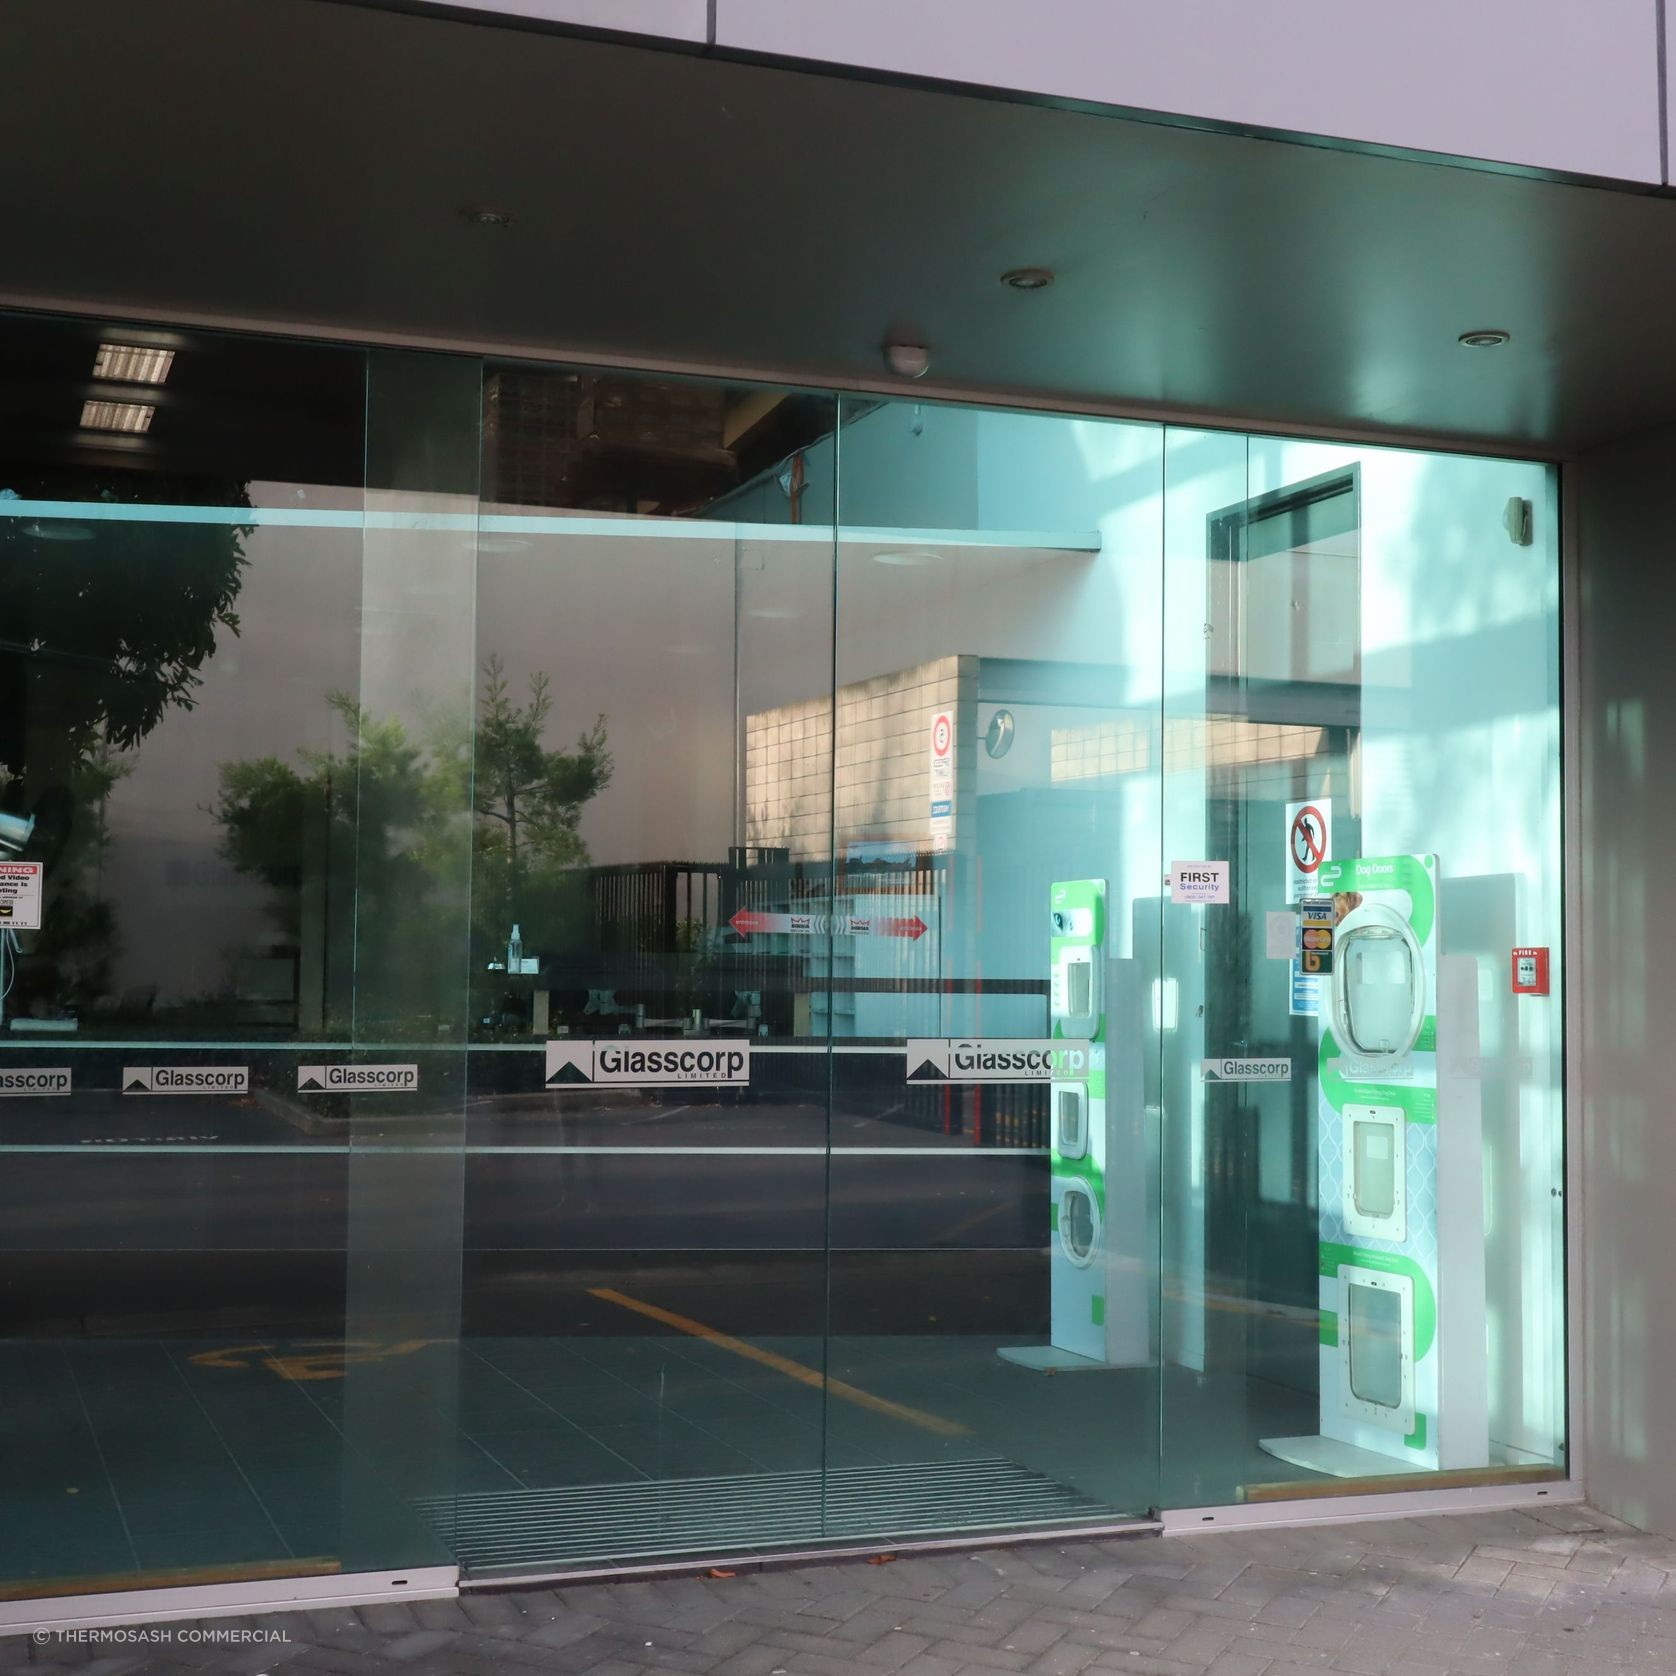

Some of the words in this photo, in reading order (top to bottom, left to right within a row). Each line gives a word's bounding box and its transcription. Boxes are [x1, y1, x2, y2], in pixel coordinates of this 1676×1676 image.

[1180, 872, 1219, 882] FIRST
[1355, 864, 1371, 875] Dog
[1372, 863, 1393, 873] Doors
[1180, 883, 1219, 892] Security
[1307, 912, 1327, 920] VISA
[600, 1044, 744, 1079] Glasscorp
[955, 1043, 1085, 1077] Glasscorp
[1224, 1060, 1289, 1077] Glasscorp
[155, 1069, 245, 1089] Glasscorp
[329, 1068, 414, 1087] Glasscorp
